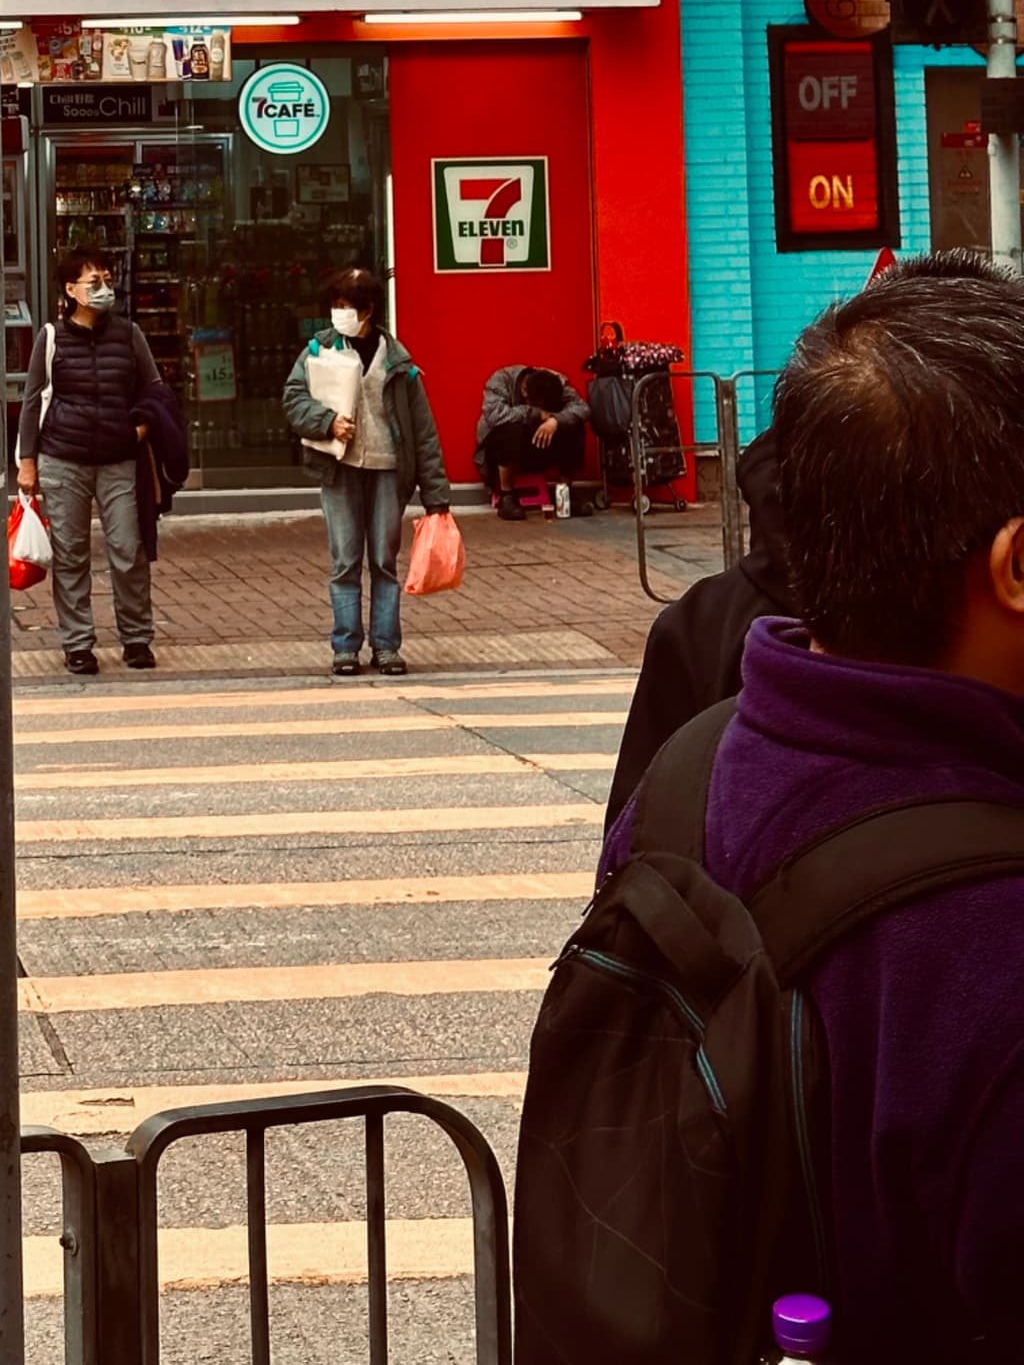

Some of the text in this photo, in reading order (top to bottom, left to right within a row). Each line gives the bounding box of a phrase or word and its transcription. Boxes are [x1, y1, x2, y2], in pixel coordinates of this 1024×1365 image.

[98, 96, 146, 117] Chill
[798, 76, 858, 111] OFF
[809, 174, 854, 210] ON
[459, 177, 522, 265] 7
